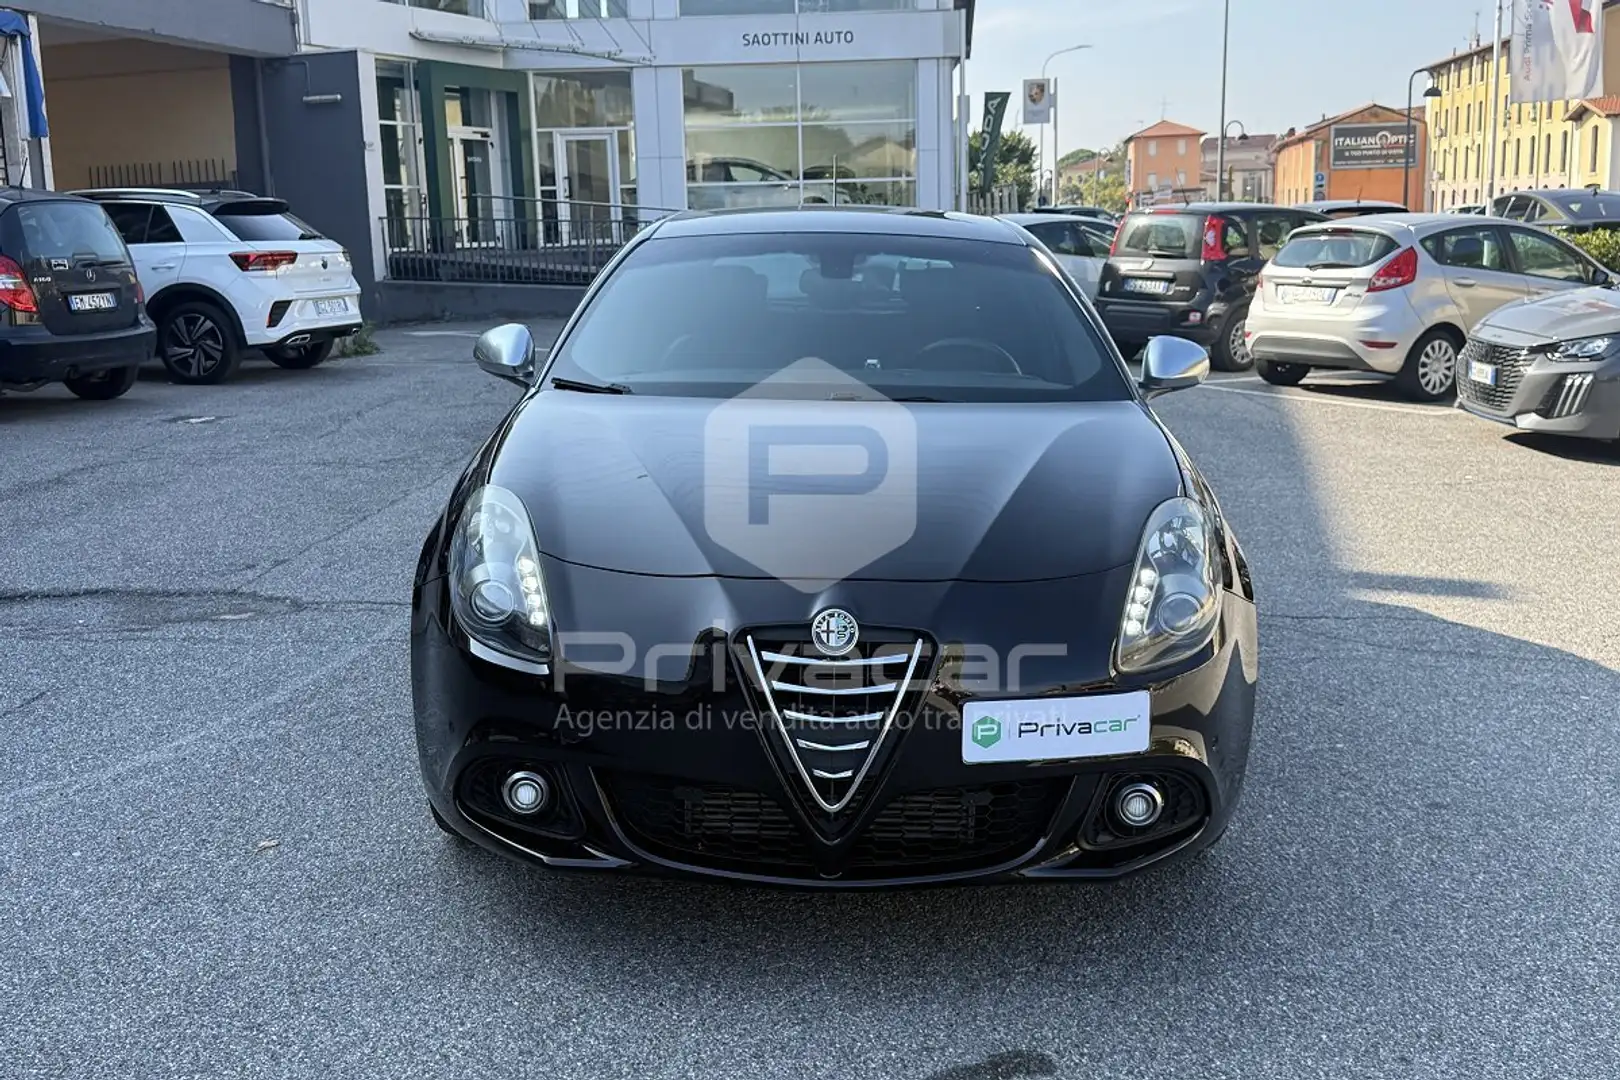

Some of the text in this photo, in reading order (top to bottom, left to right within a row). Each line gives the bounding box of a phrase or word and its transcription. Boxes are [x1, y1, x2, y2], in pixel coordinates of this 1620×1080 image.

[742, 30, 854, 47] SAOTTINI AUTO
[1018, 716, 1138, 738] Privacar
